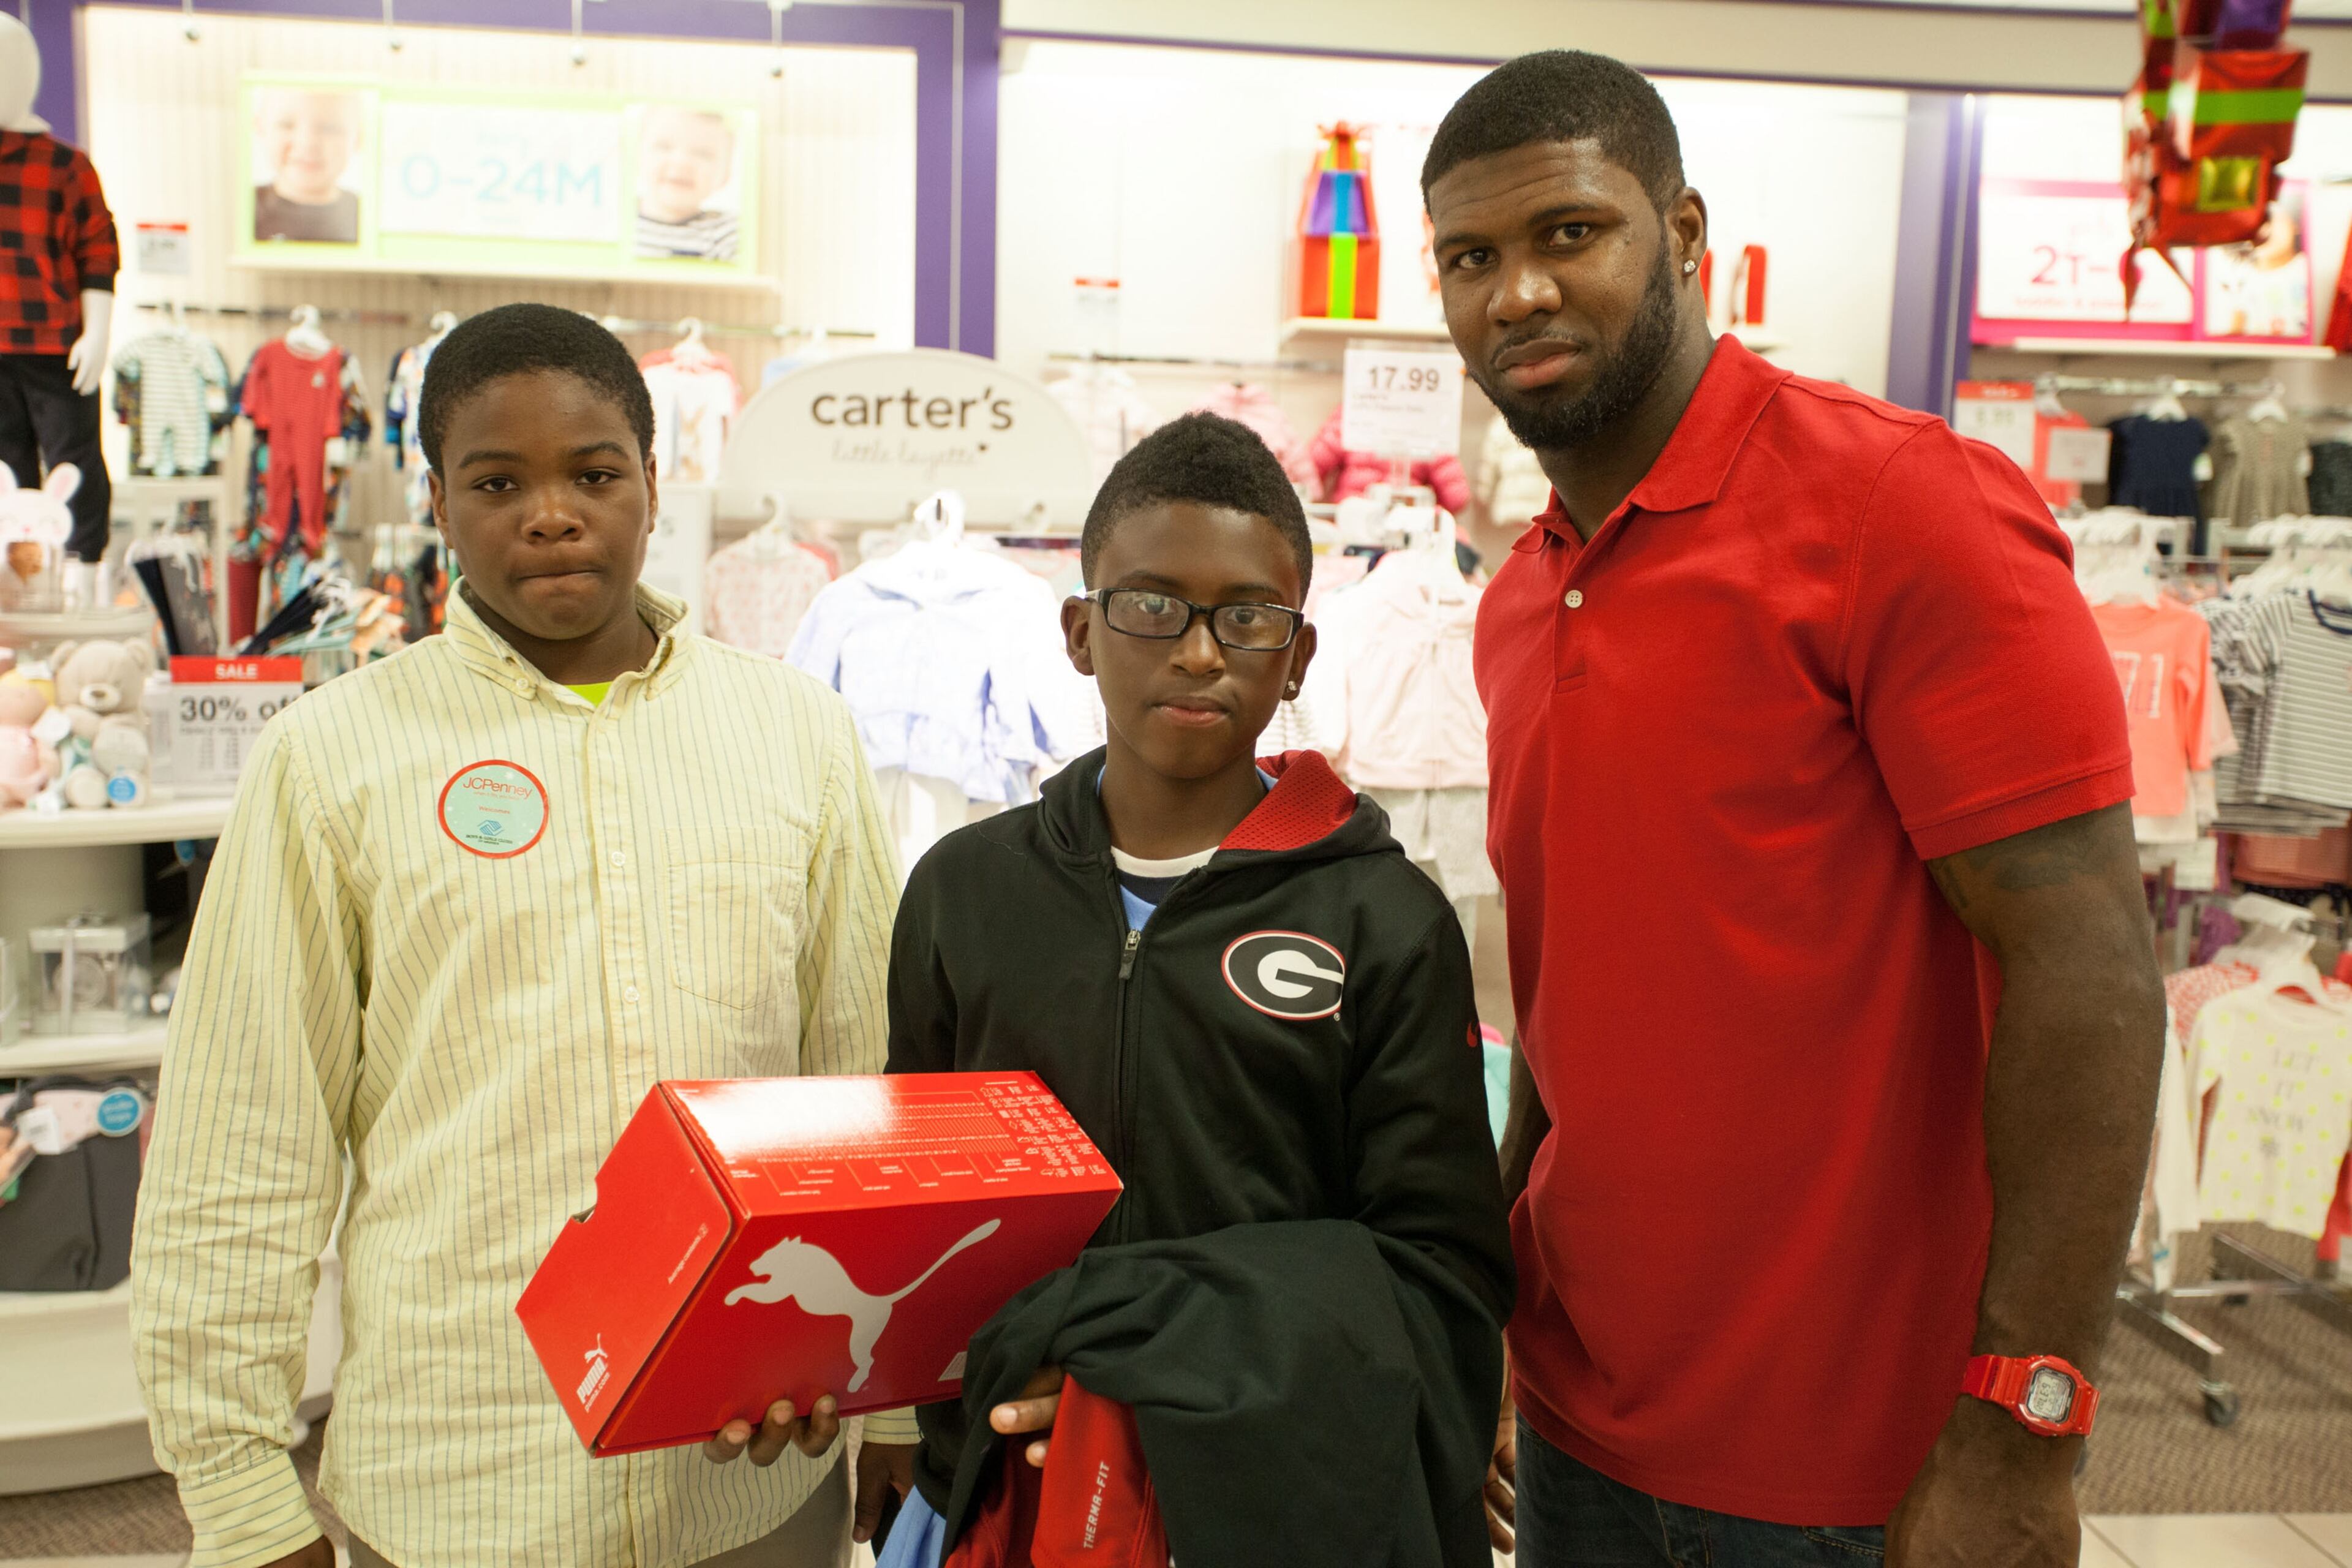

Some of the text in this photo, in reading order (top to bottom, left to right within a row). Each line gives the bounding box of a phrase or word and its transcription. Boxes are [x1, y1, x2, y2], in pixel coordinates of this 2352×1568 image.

[1369, 367, 1440, 391] 17.99
[810, 386, 1014, 431] carter's
[216, 663, 258, 680] SALE
[180, 696, 247, 722] 30%
[463, 777, 533, 799] JCPenney
[576, 1356, 608, 1405] PUMA
[1083, 1461, 1110, 1549] THERMA-FIT
